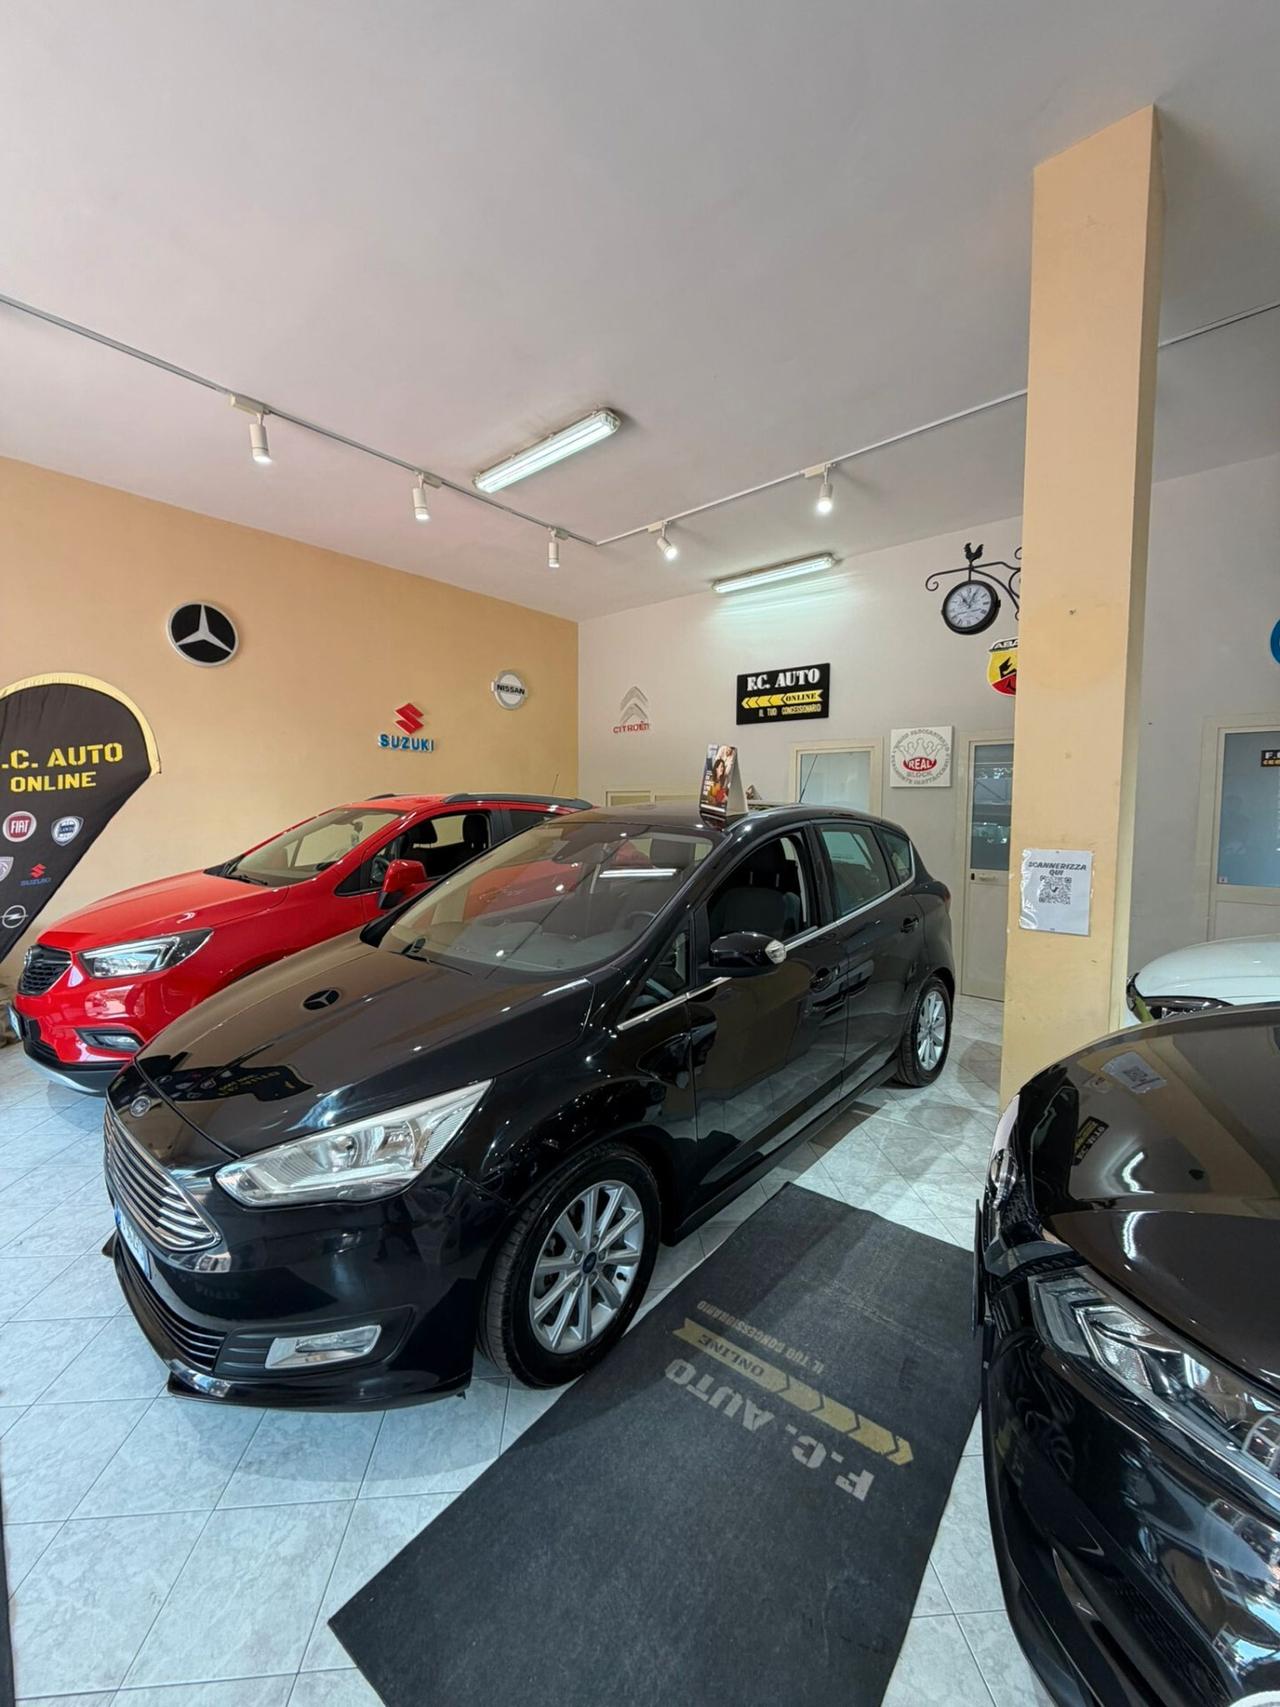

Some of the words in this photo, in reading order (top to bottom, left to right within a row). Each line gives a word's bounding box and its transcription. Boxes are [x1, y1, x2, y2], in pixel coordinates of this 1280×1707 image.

[774, 668, 820, 688] AUTO
[496, 683, 525, 695] NISSAN
[785, 692, 817, 702] ONLINE
[378, 733, 434, 752] SUZUKI
[47, 742, 123, 768] AUTO
[907, 758, 934, 770] REAL
[10, 771, 97, 792] ONLINE
[10, 819, 30, 834] FIAT
[1028, 861, 1087, 871] SCANNERIZZA
[696, 1300, 786, 1354] CONCESSIONARIO
[698, 1333, 765, 1377] ONLINE
[785, 1346, 811, 1369] TUO
[664, 1358, 775, 1432] AUTO
[784, 1423, 875, 1502] F.C.
